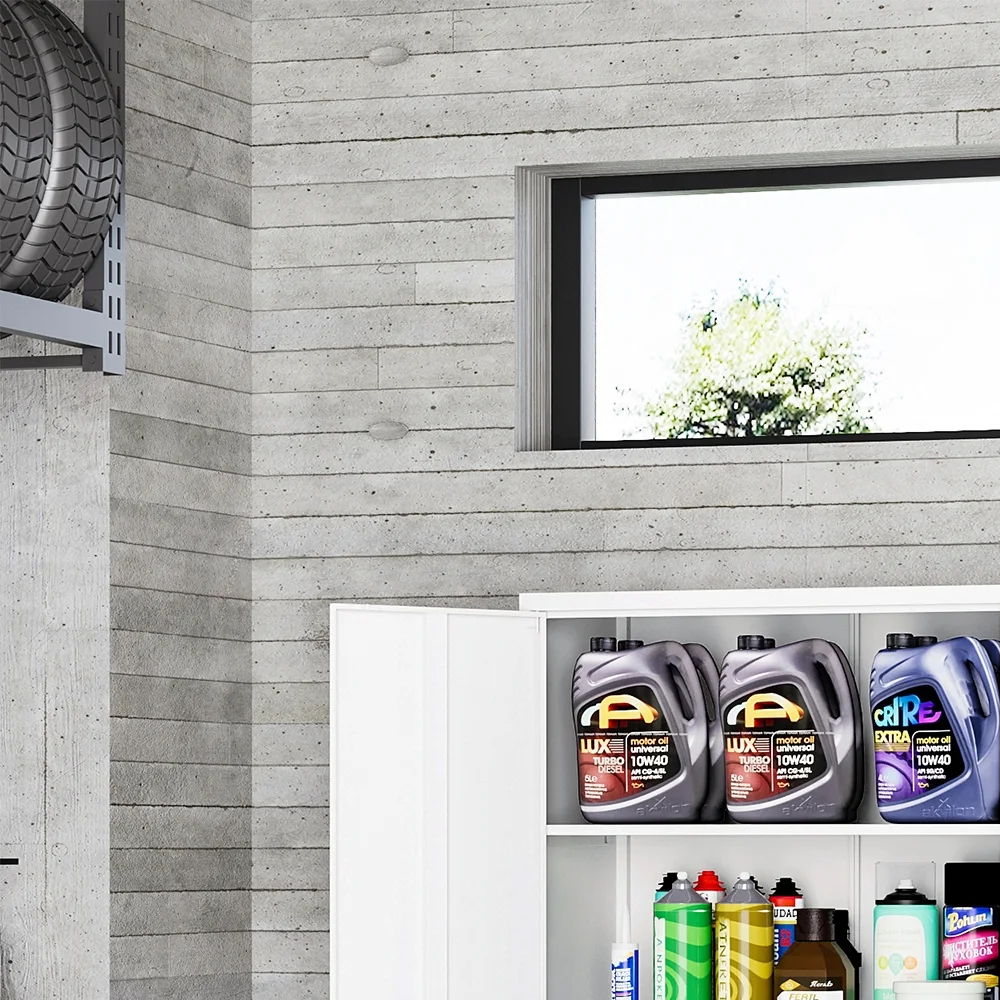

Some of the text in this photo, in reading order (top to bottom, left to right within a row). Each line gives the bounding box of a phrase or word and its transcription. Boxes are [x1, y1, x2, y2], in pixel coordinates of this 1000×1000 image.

[630, 736, 669, 746] motor oil
[776, 735, 815, 745] motor oil
[874, 730, 912, 743] EXTRA
[916, 735, 951, 745] motor oil
[580, 738, 612, 754] LUX
[630, 744, 669, 753] universal
[726, 737, 758, 753] LUX
[776, 743, 815, 752] universal
[916, 743, 951, 752] universal
[592, 756, 625, 766] TURBO
[630, 755, 669, 767] 10W40
[739, 756, 771, 765] TURBO
[776, 754, 815, 766] 10W40
[916, 754, 952, 766] 10W40
[598, 765, 625, 774] DIESEL
[744, 764, 770, 773] DIESEL
[950, 946, 994, 962] УХОВОК
